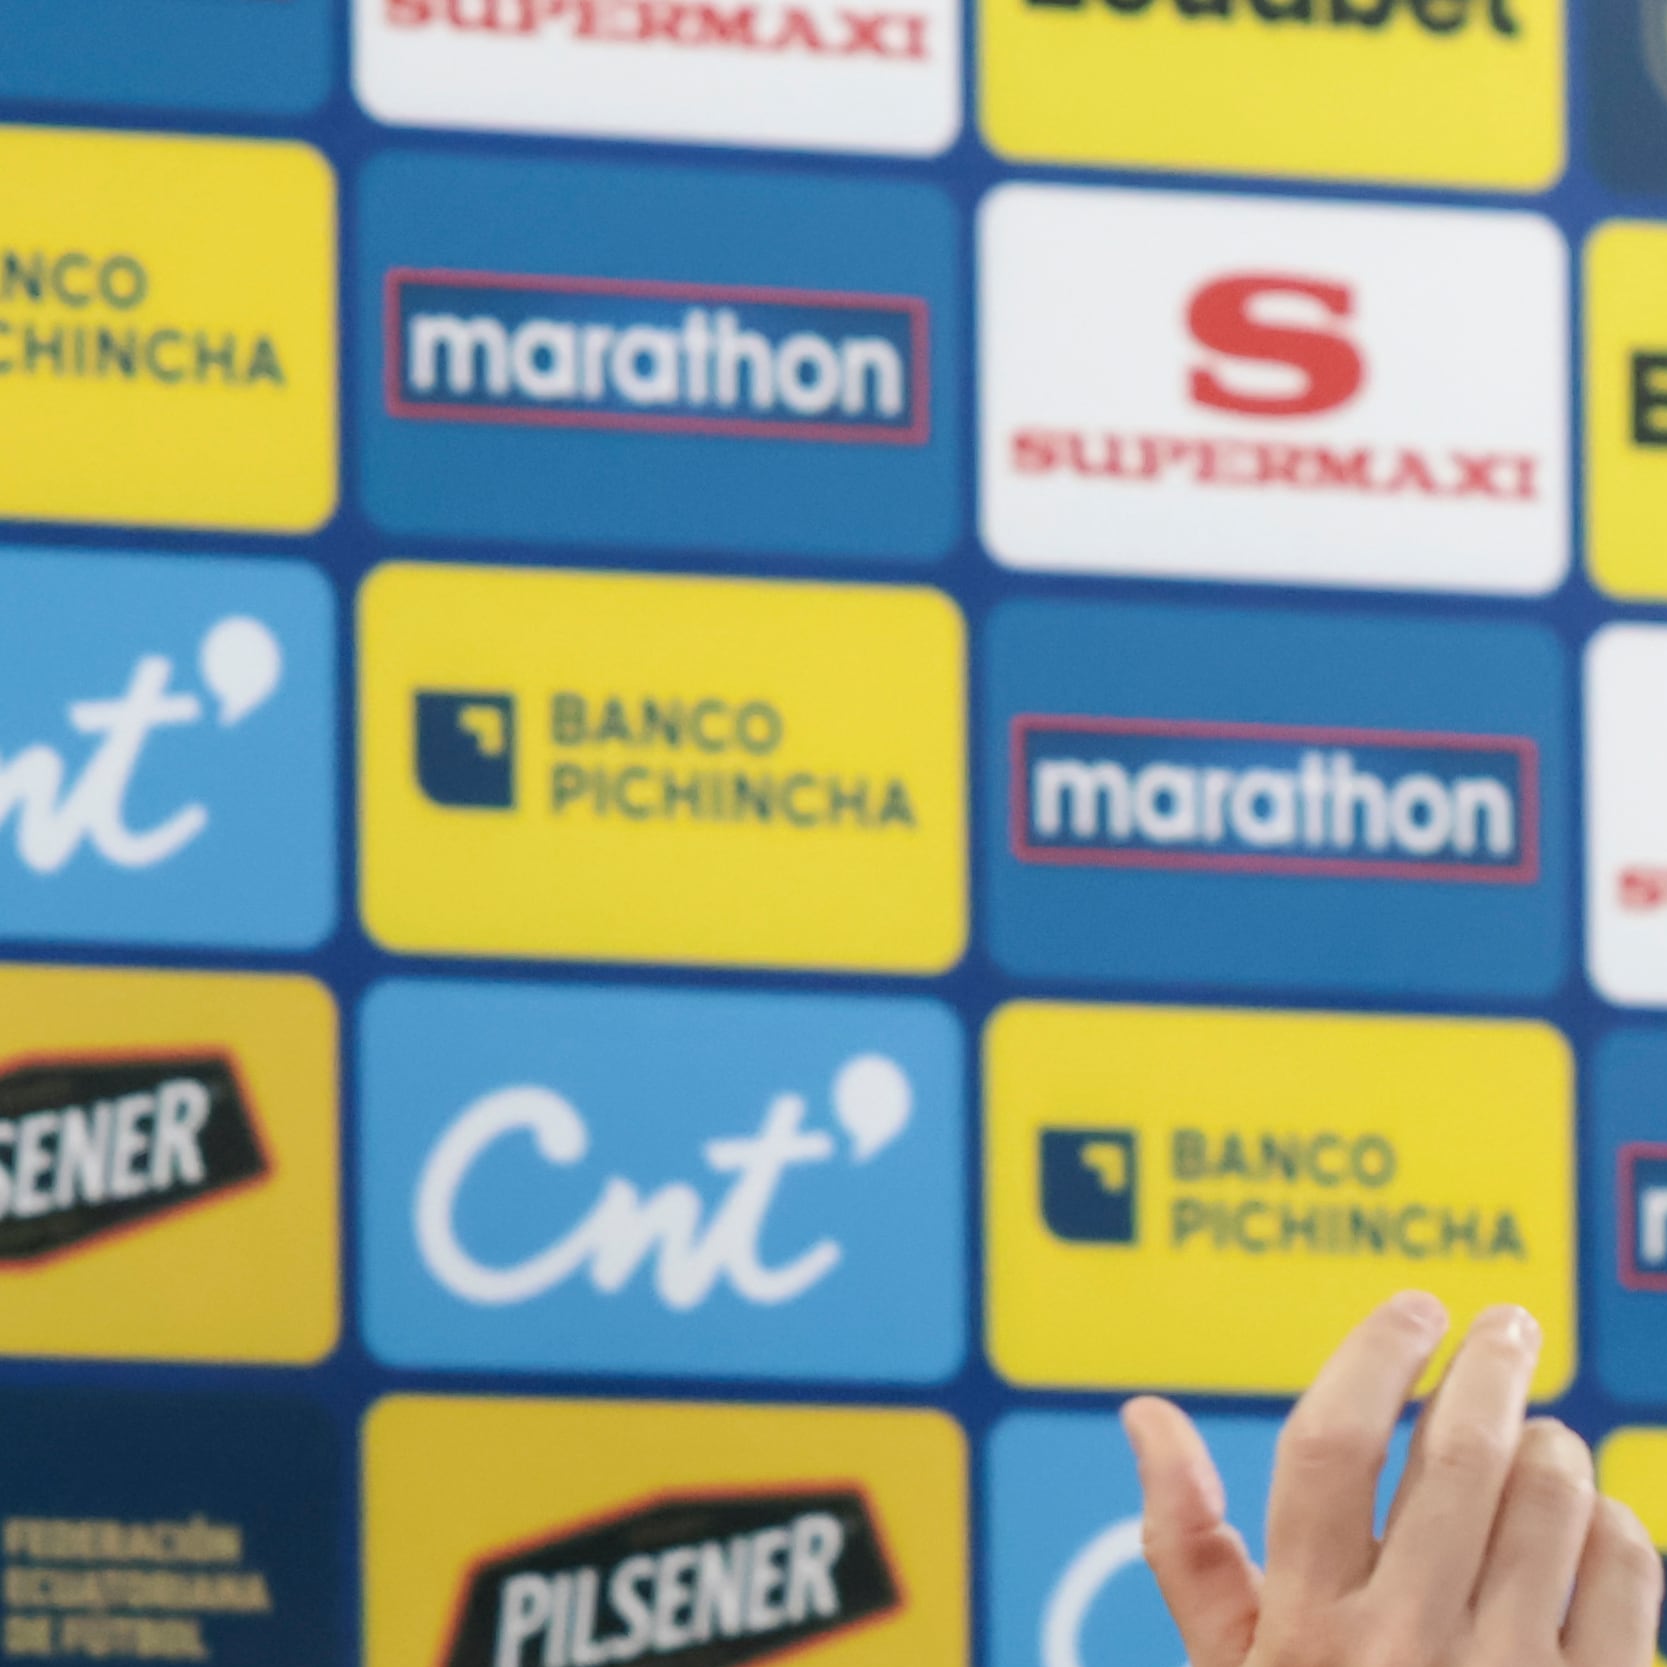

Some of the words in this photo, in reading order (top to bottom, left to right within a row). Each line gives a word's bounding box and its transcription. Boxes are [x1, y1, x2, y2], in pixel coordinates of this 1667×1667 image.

[0, 250, 148, 312] NCO
[0, 319, 285, 386] HINCHA
[410, 308, 903, 416] marathon
[1185, 272, 1367, 420] S
[1010, 428, 1537, 501] SUPERMAXI
[549, 691, 782, 756] BANCO
[549, 760, 917, 829] PICHINCHA
[1035, 751, 1514, 854] marathon
[0, 1079, 210, 1219] ENER
[1170, 1127, 1396, 1190] BANCO
[1169, 1196, 1526, 1260] PICHINCHA
